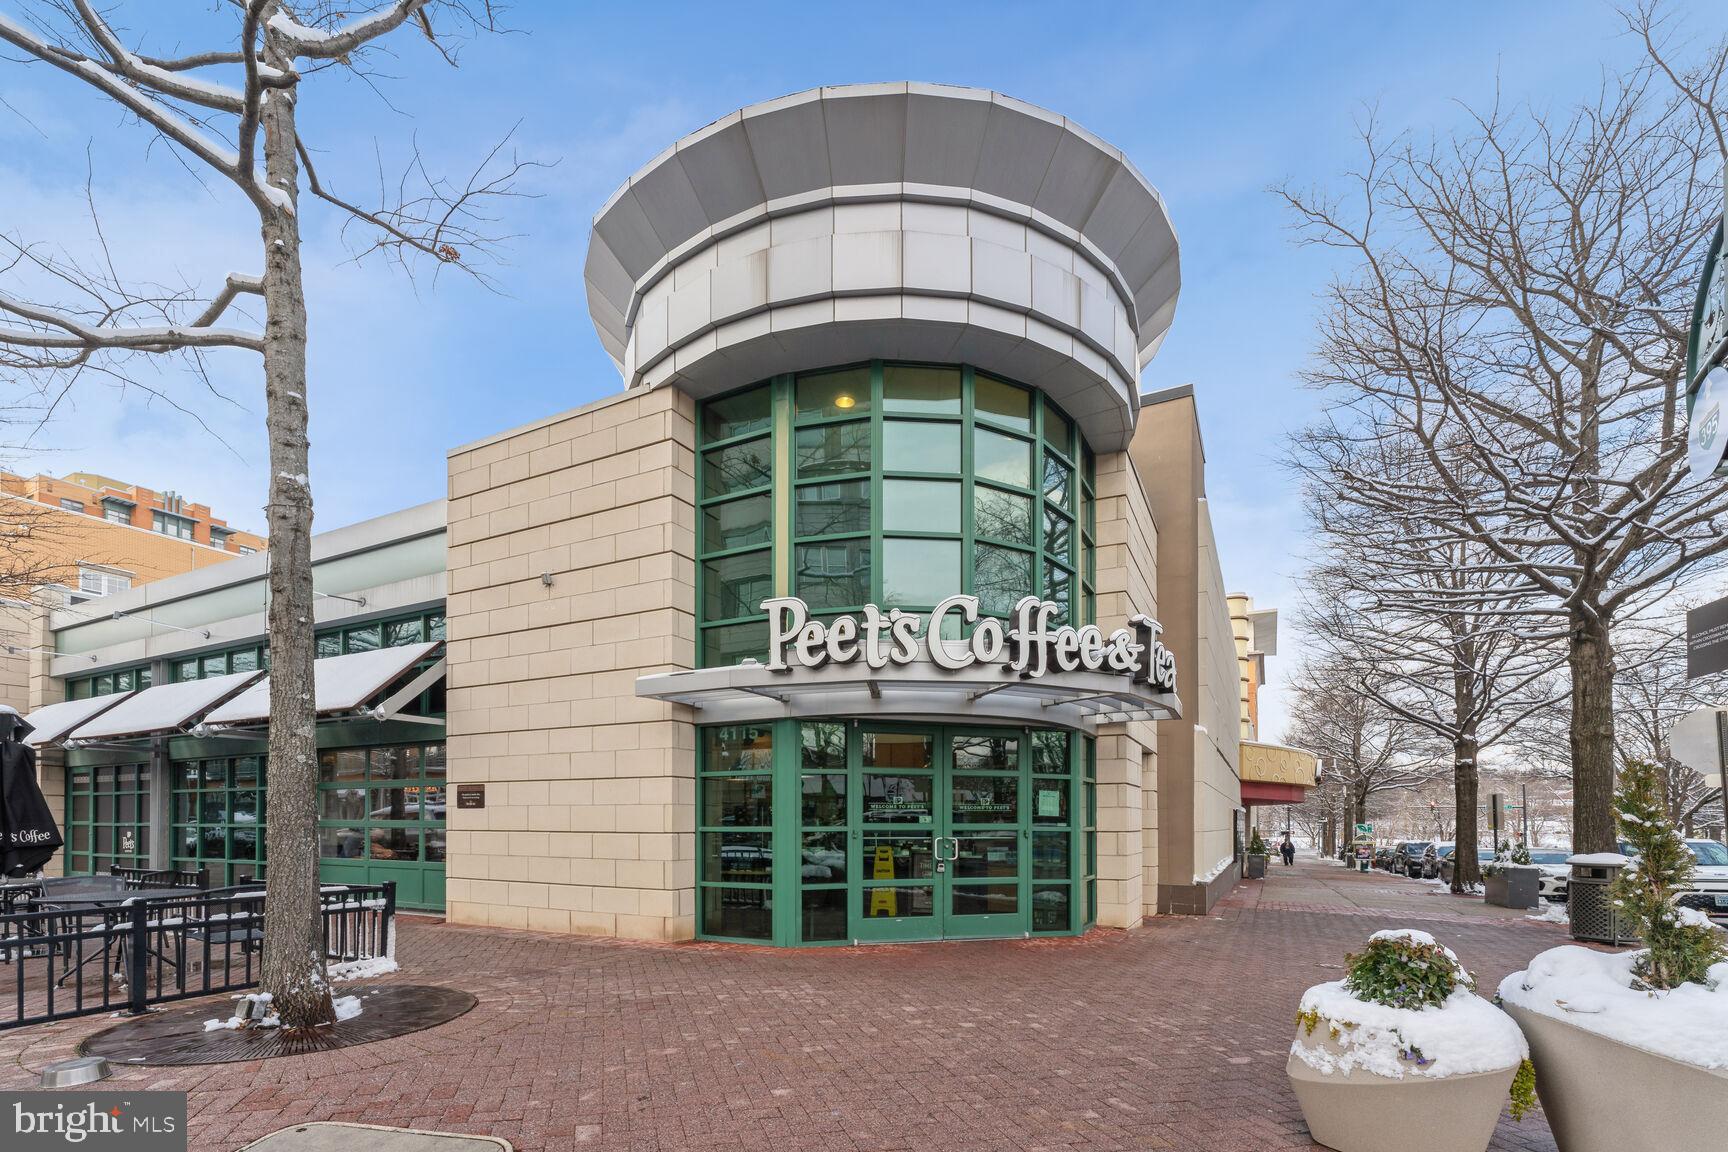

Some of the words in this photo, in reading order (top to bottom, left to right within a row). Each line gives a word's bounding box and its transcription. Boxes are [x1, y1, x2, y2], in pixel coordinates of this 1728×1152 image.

[1699, 413, 1718, 446] 395
[760, 597, 920, 673] Peet's
[925, 593, 1104, 680] Coffee
[1107, 628, 1145, 673] &
[1129, 614, 1178, 692] Tea
[19, 829, 51, 843] Coffee
